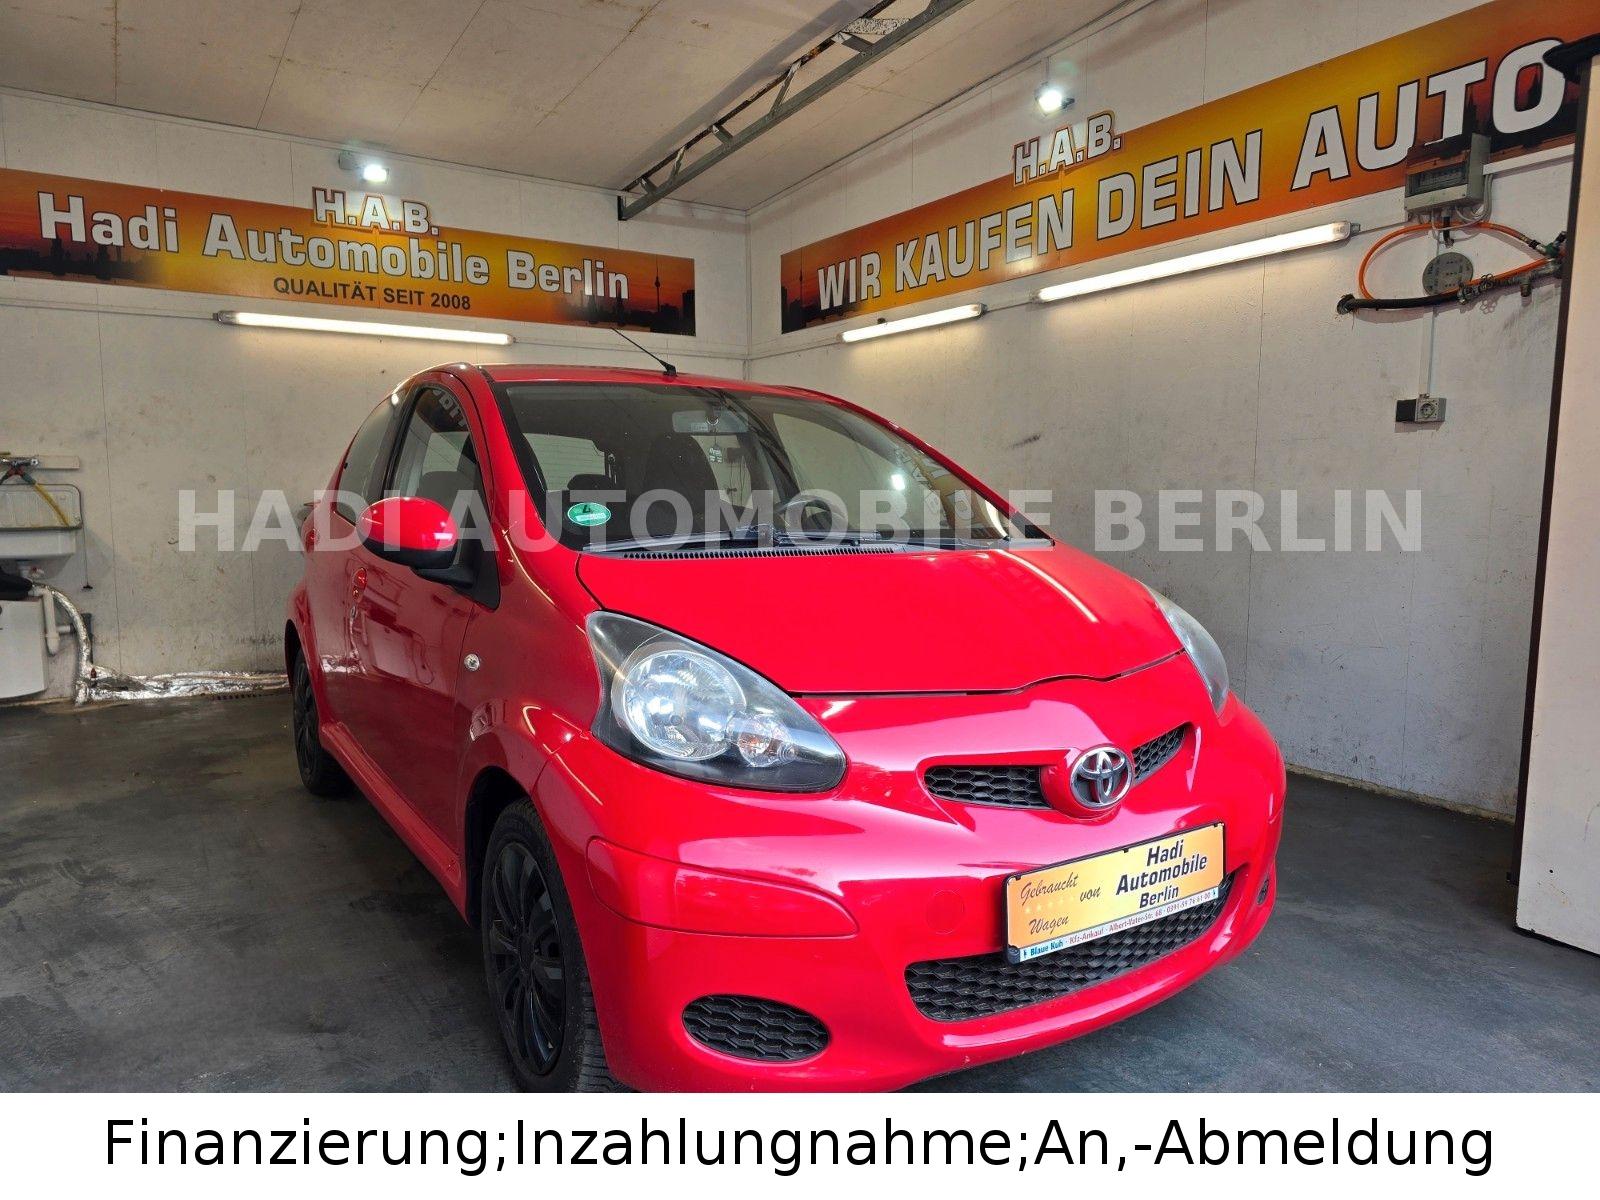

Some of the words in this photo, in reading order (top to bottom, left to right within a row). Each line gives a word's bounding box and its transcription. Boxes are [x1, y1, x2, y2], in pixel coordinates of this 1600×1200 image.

[1015, 113, 1123, 185] H.A.B.
[817, 252, 883, 311] WIR
[894, 193, 1076, 292] KAUFEN
[1096, 129, 1265, 240] DEIN
[1290, 37, 1567, 192] AUTO
[313, 187, 440, 236] H.A.B.
[37, 190, 180, 254] Hadi
[202, 212, 491, 286] Automobile
[506, 249, 630, 300] Berlin
[272, 276, 377, 302] QUALITÄT
[383, 287, 424, 306] SEIT
[430, 291, 471, 311] 2008
[1146, 839, 1184, 867] Hadi
[1020, 871, 1079, 906] Gebraucht
[1116, 855, 1207, 895] Automobile
[1079, 886, 1101, 902] von
[1139, 885, 1179, 908] Berlin
[1028, 915, 1069, 936] Wagen
